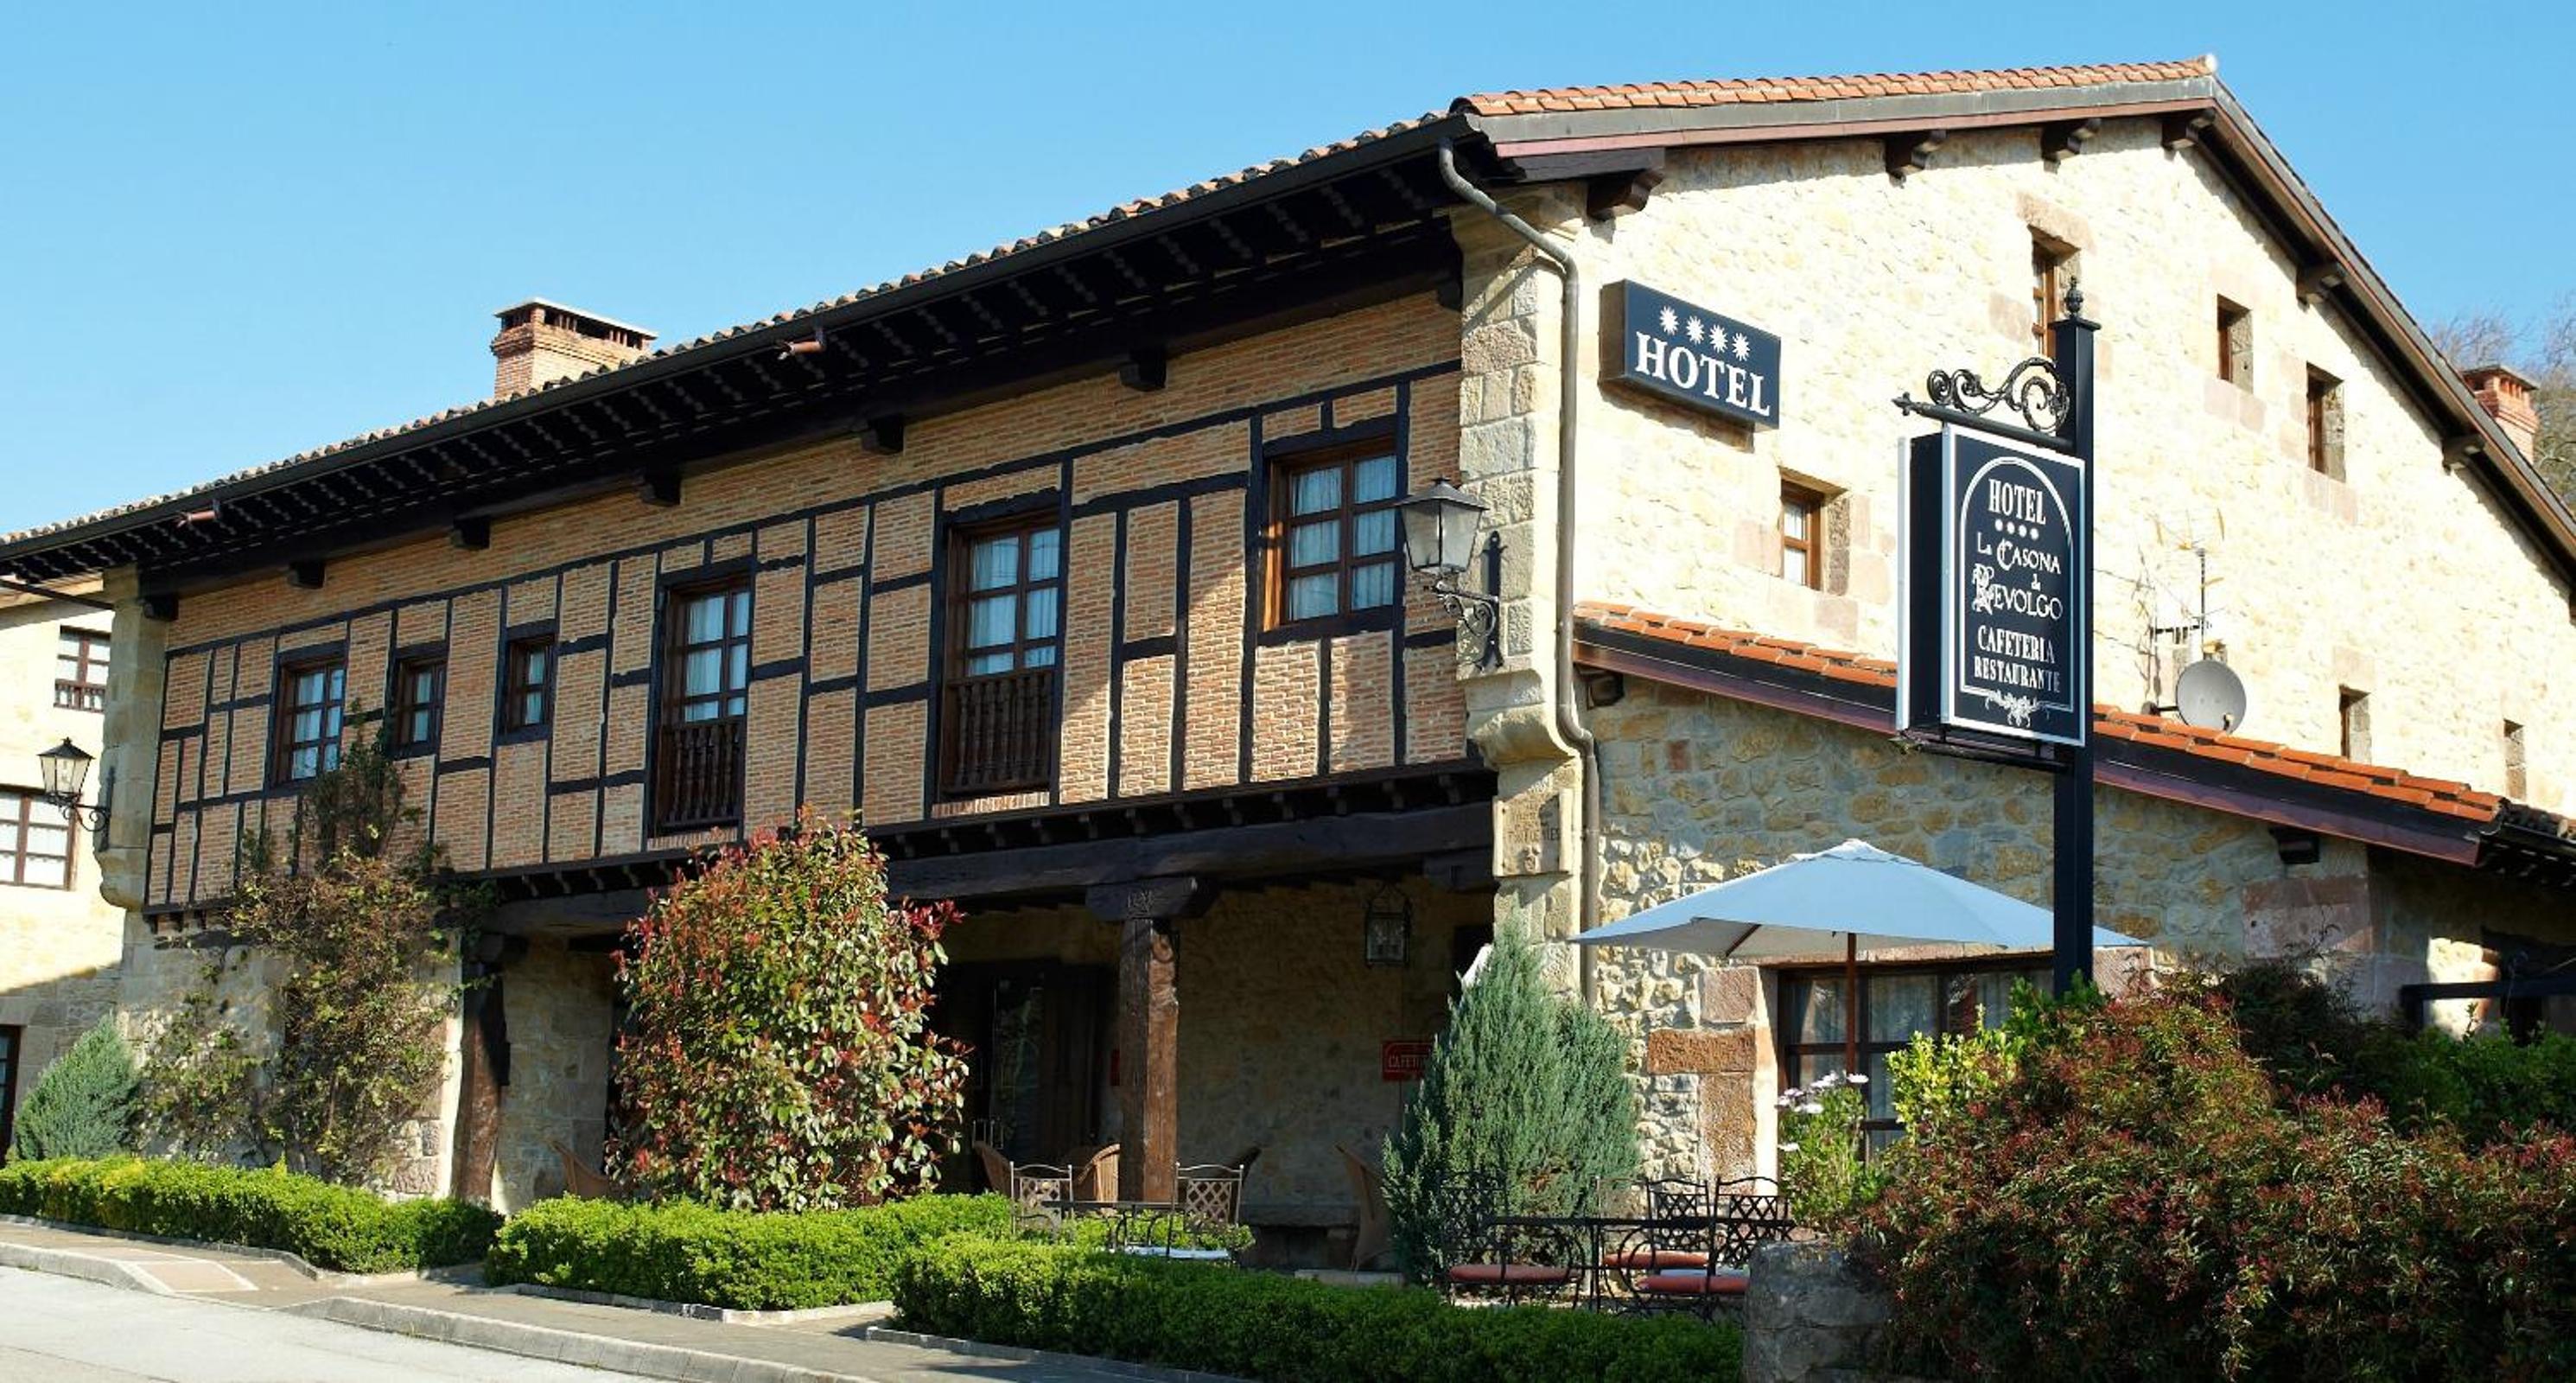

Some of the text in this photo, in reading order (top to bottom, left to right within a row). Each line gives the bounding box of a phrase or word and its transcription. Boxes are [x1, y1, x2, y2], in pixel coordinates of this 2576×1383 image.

[1635, 331, 1771, 417] HOTEL
[1988, 478, 2046, 526] HOTEL
[1971, 563, 2064, 621] REVOLGO
[1977, 624, 2056, 665] CAFETERIA
[1974, 655, 2061, 693] RESTAURANTE
